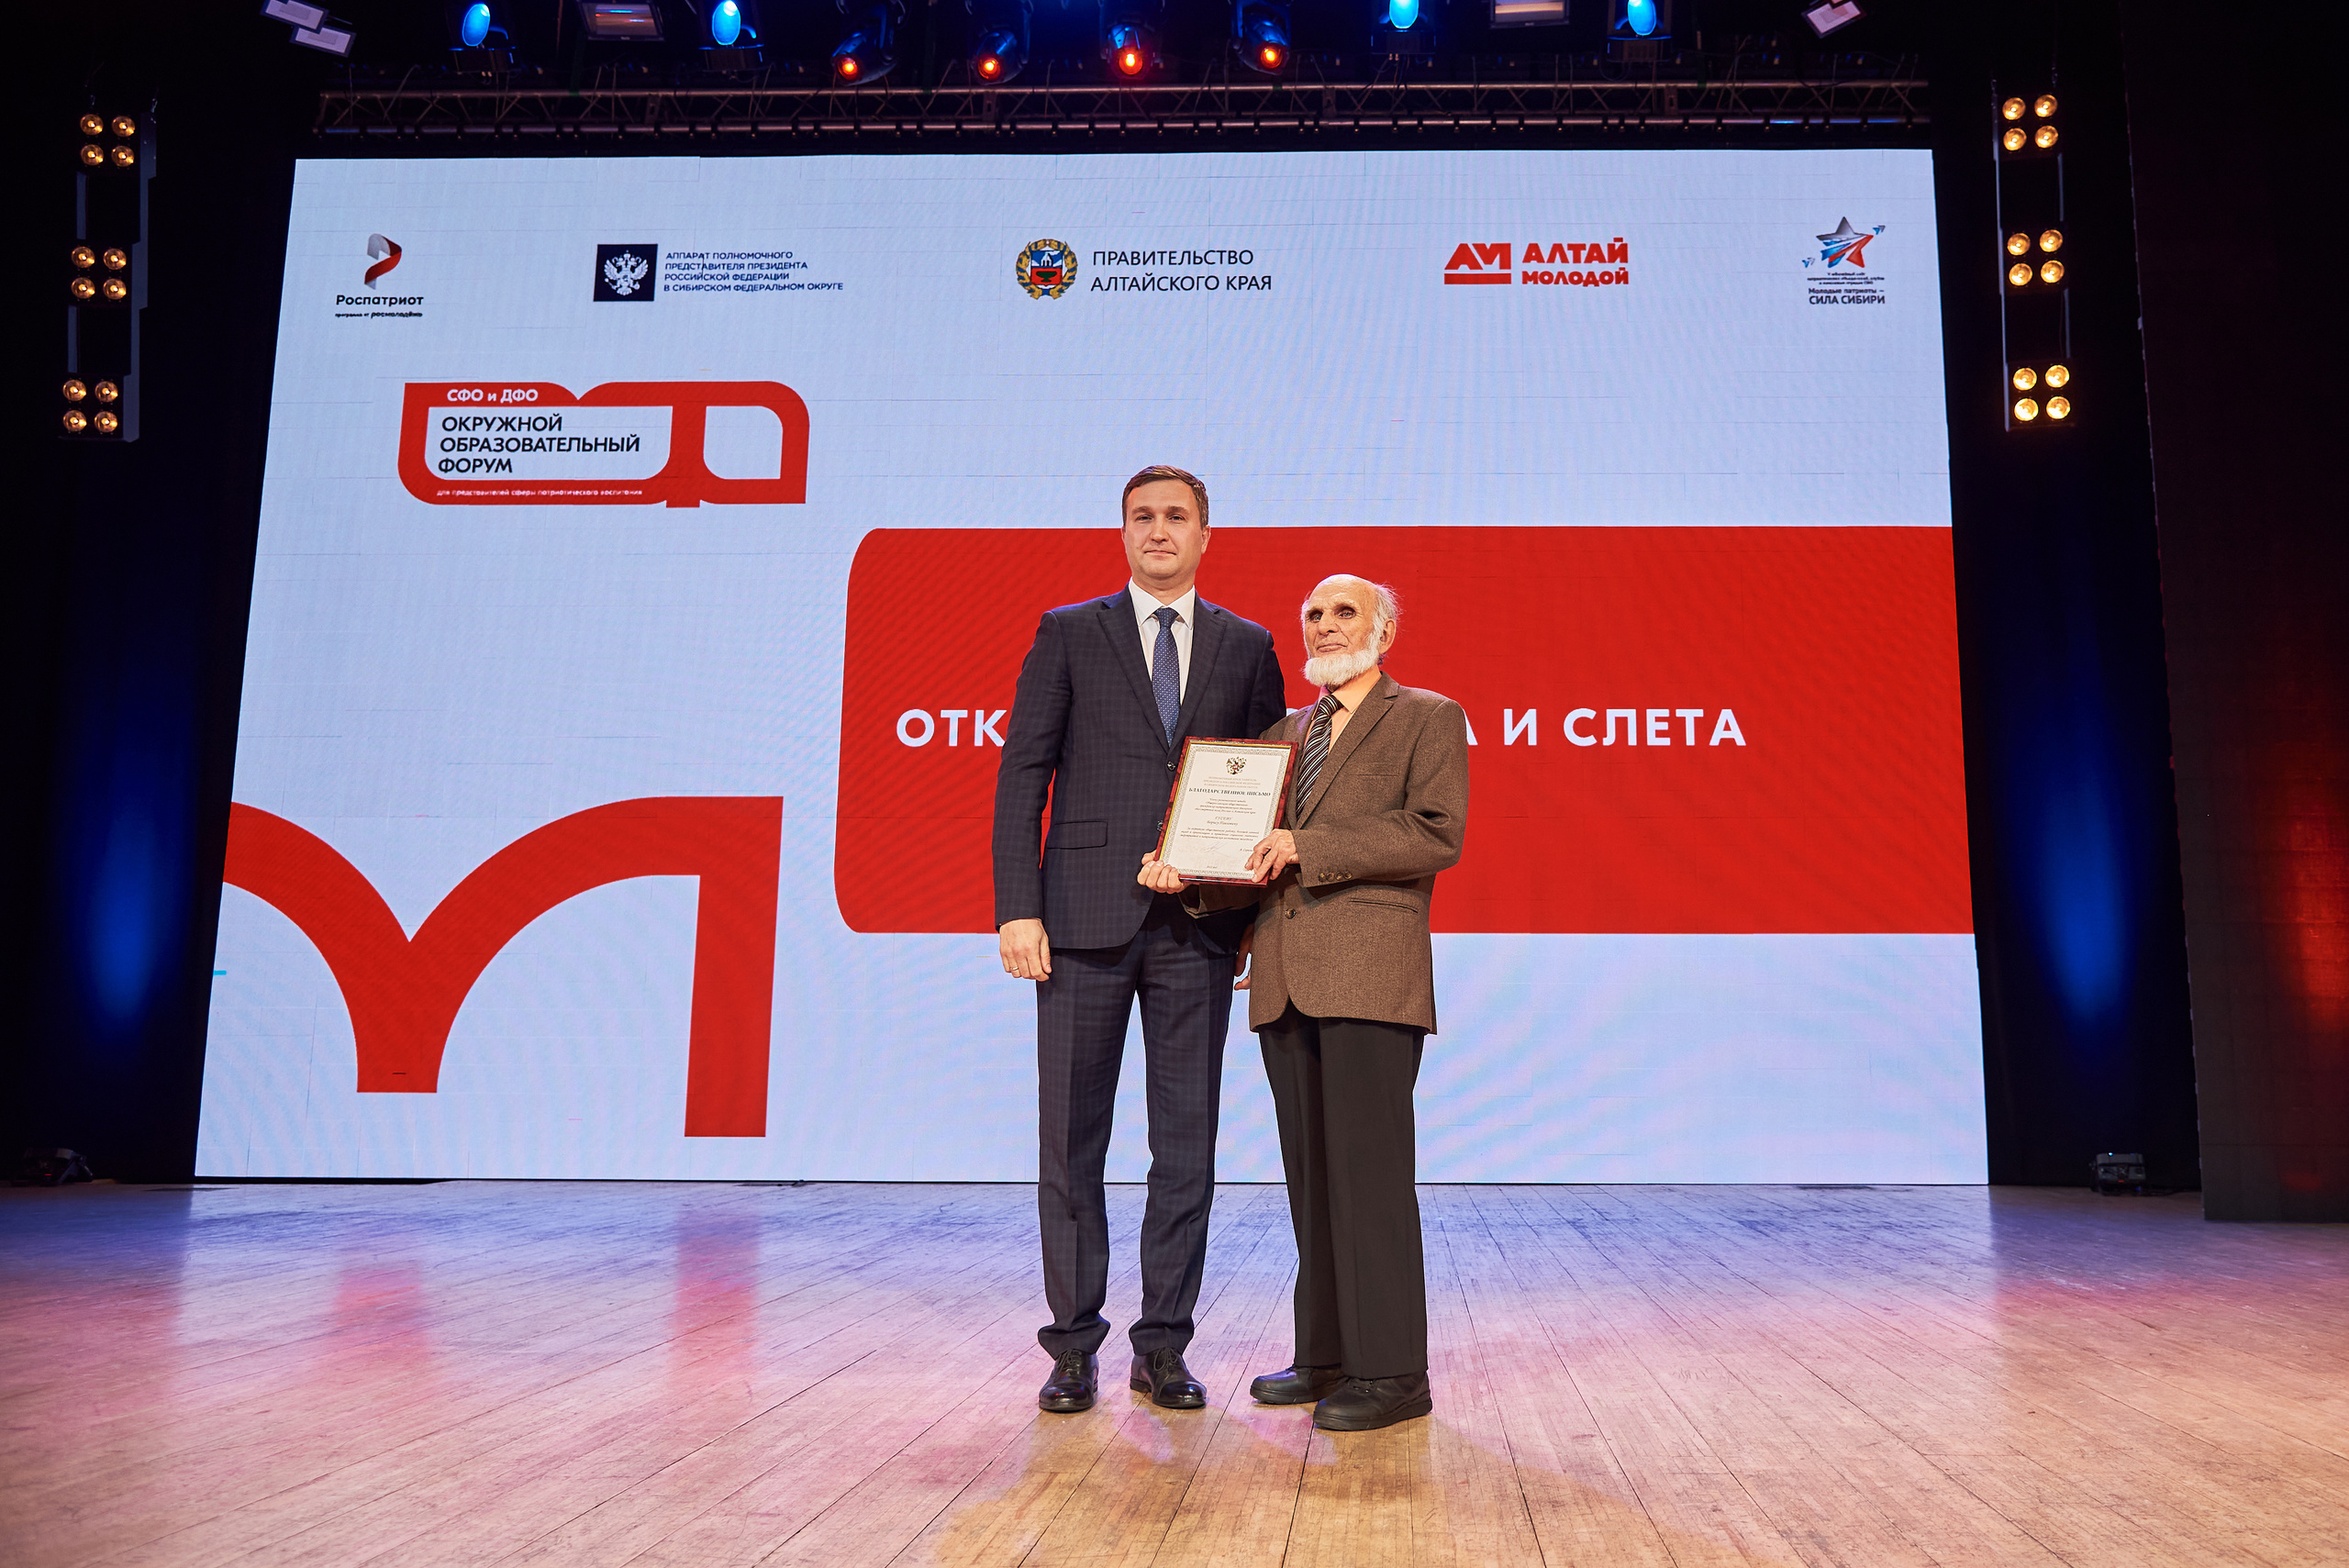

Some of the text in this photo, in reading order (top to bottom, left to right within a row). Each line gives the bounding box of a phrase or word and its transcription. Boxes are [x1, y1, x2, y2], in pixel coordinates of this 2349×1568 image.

[665, 251, 794, 260] АППАРАТ ПОЛНОМОЧНОГО
[1093, 250, 1254, 265] ПРАВИТЕЛЬСТВО
[1522, 237, 1629, 264] АЛТАЙ
[664, 261, 808, 272] ПРЕДСТАВИТЕЛЯ ПРЕЗИДЕНТА
[664, 272, 790, 282] РОССИЙСКОЙ ФЕДЕРАЦИИ
[1090, 272, 1272, 292] АЛТАЙСКОГО КРАЯ
[1521, 267, 1630, 287] МОЛОДОЙ
[672, 284, 731, 292] СИБИРСКОМ
[733, 284, 805, 292] ФЕДЕРАЛЬНОМ
[807, 283, 843, 291] ОКРУГЕ
[336, 295, 424, 307] Роспатриот
[1809, 295, 1886, 306] СИЛА СИБИРИ
[447, 389, 539, 404] СФО и ДФО
[441, 413, 562, 432] ОКРУЖНОЙ
[440, 434, 640, 453] ОБРАЗОВАТЕЛЬНЫЙ
[438, 457, 514, 473] ФОРУМ
[896, 708, 1008, 747] ОТК
[1503, 708, 1538, 746] И
[1563, 707, 1747, 747] СЛЕТА
